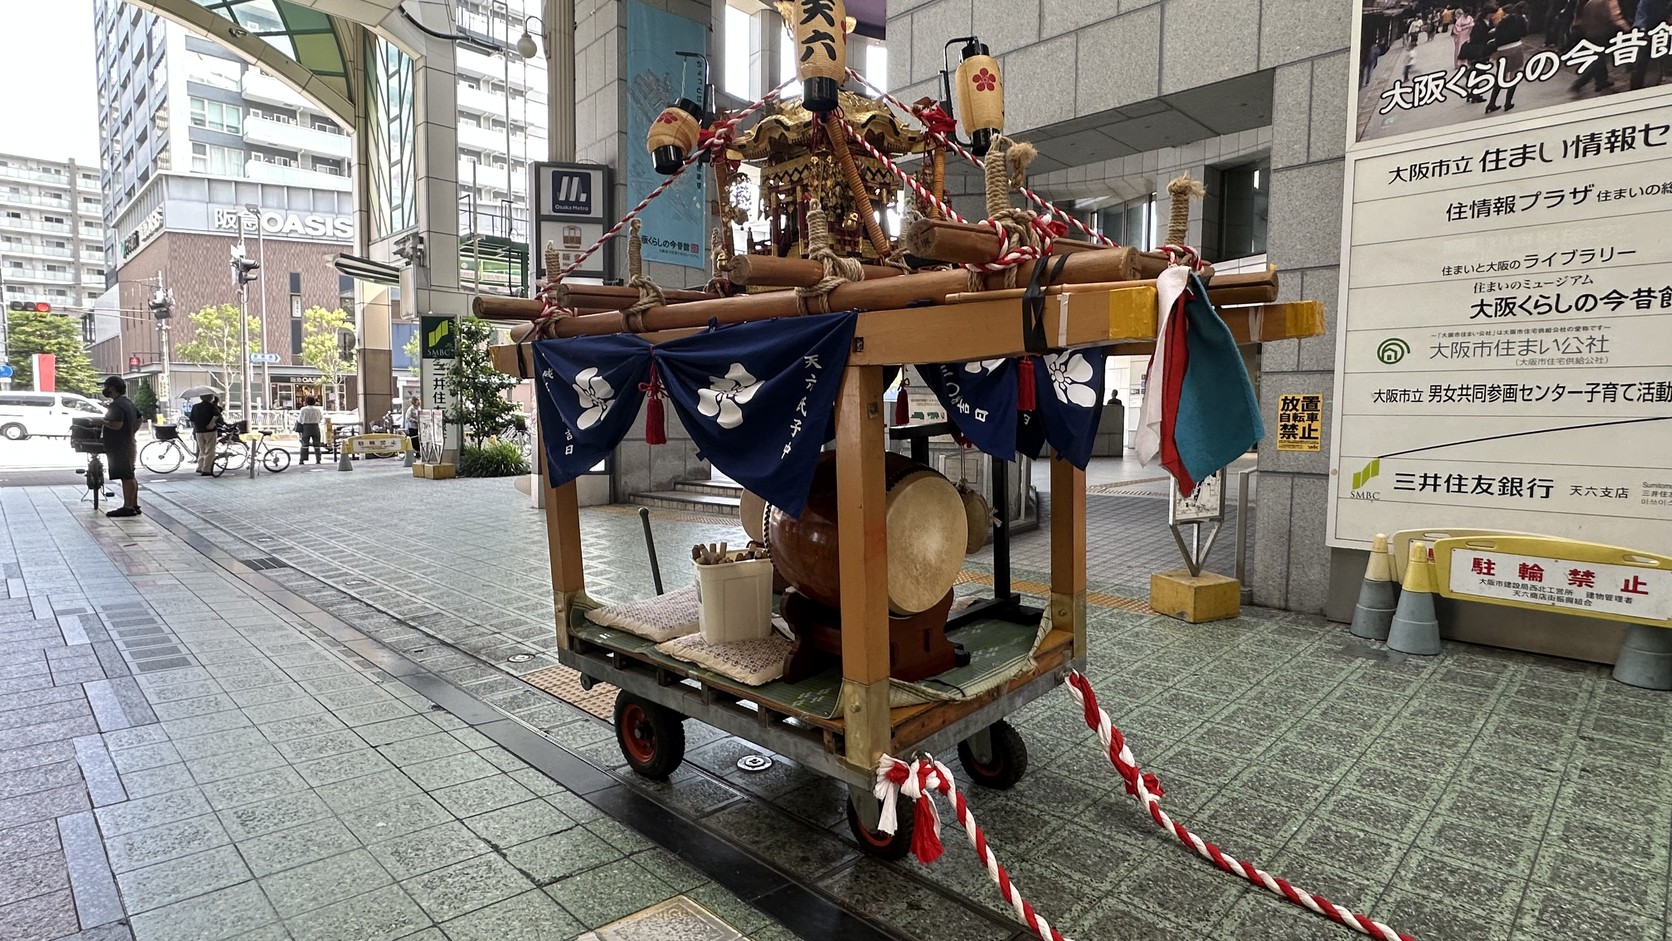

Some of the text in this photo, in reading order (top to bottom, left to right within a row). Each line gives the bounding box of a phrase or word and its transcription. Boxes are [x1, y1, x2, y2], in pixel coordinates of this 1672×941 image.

[799, 0, 837, 62] 天六
[1379, 22, 1672, 114] 大阪くらしの今昔館
[1388, 123, 1671, 185] 大阪市立 住まい情報セ
[1446, 183, 1595, 222] 住情報プラザ
[1473, 274, 1594, 294] 住まいのミュージアム
[427, 348, 450, 356] SMBC
[1429, 334, 1610, 359] 大阪市住まい公社
[1281, 396, 1321, 412] 放置
[1373, 380, 1672, 404] 大阪市立 男女共同参画センター子育て活動
[1279, 412, 1319, 423] 自転車
[1279, 423, 1319, 440] 禁止
[1350, 490, 1380, 501] SMBC
[1393, 472, 1629, 499] 三井住友銀行 天六支店
[1471, 557, 1649, 595] 駐輪禁止
[1585, 591, 1633, 604] 建物管理者
